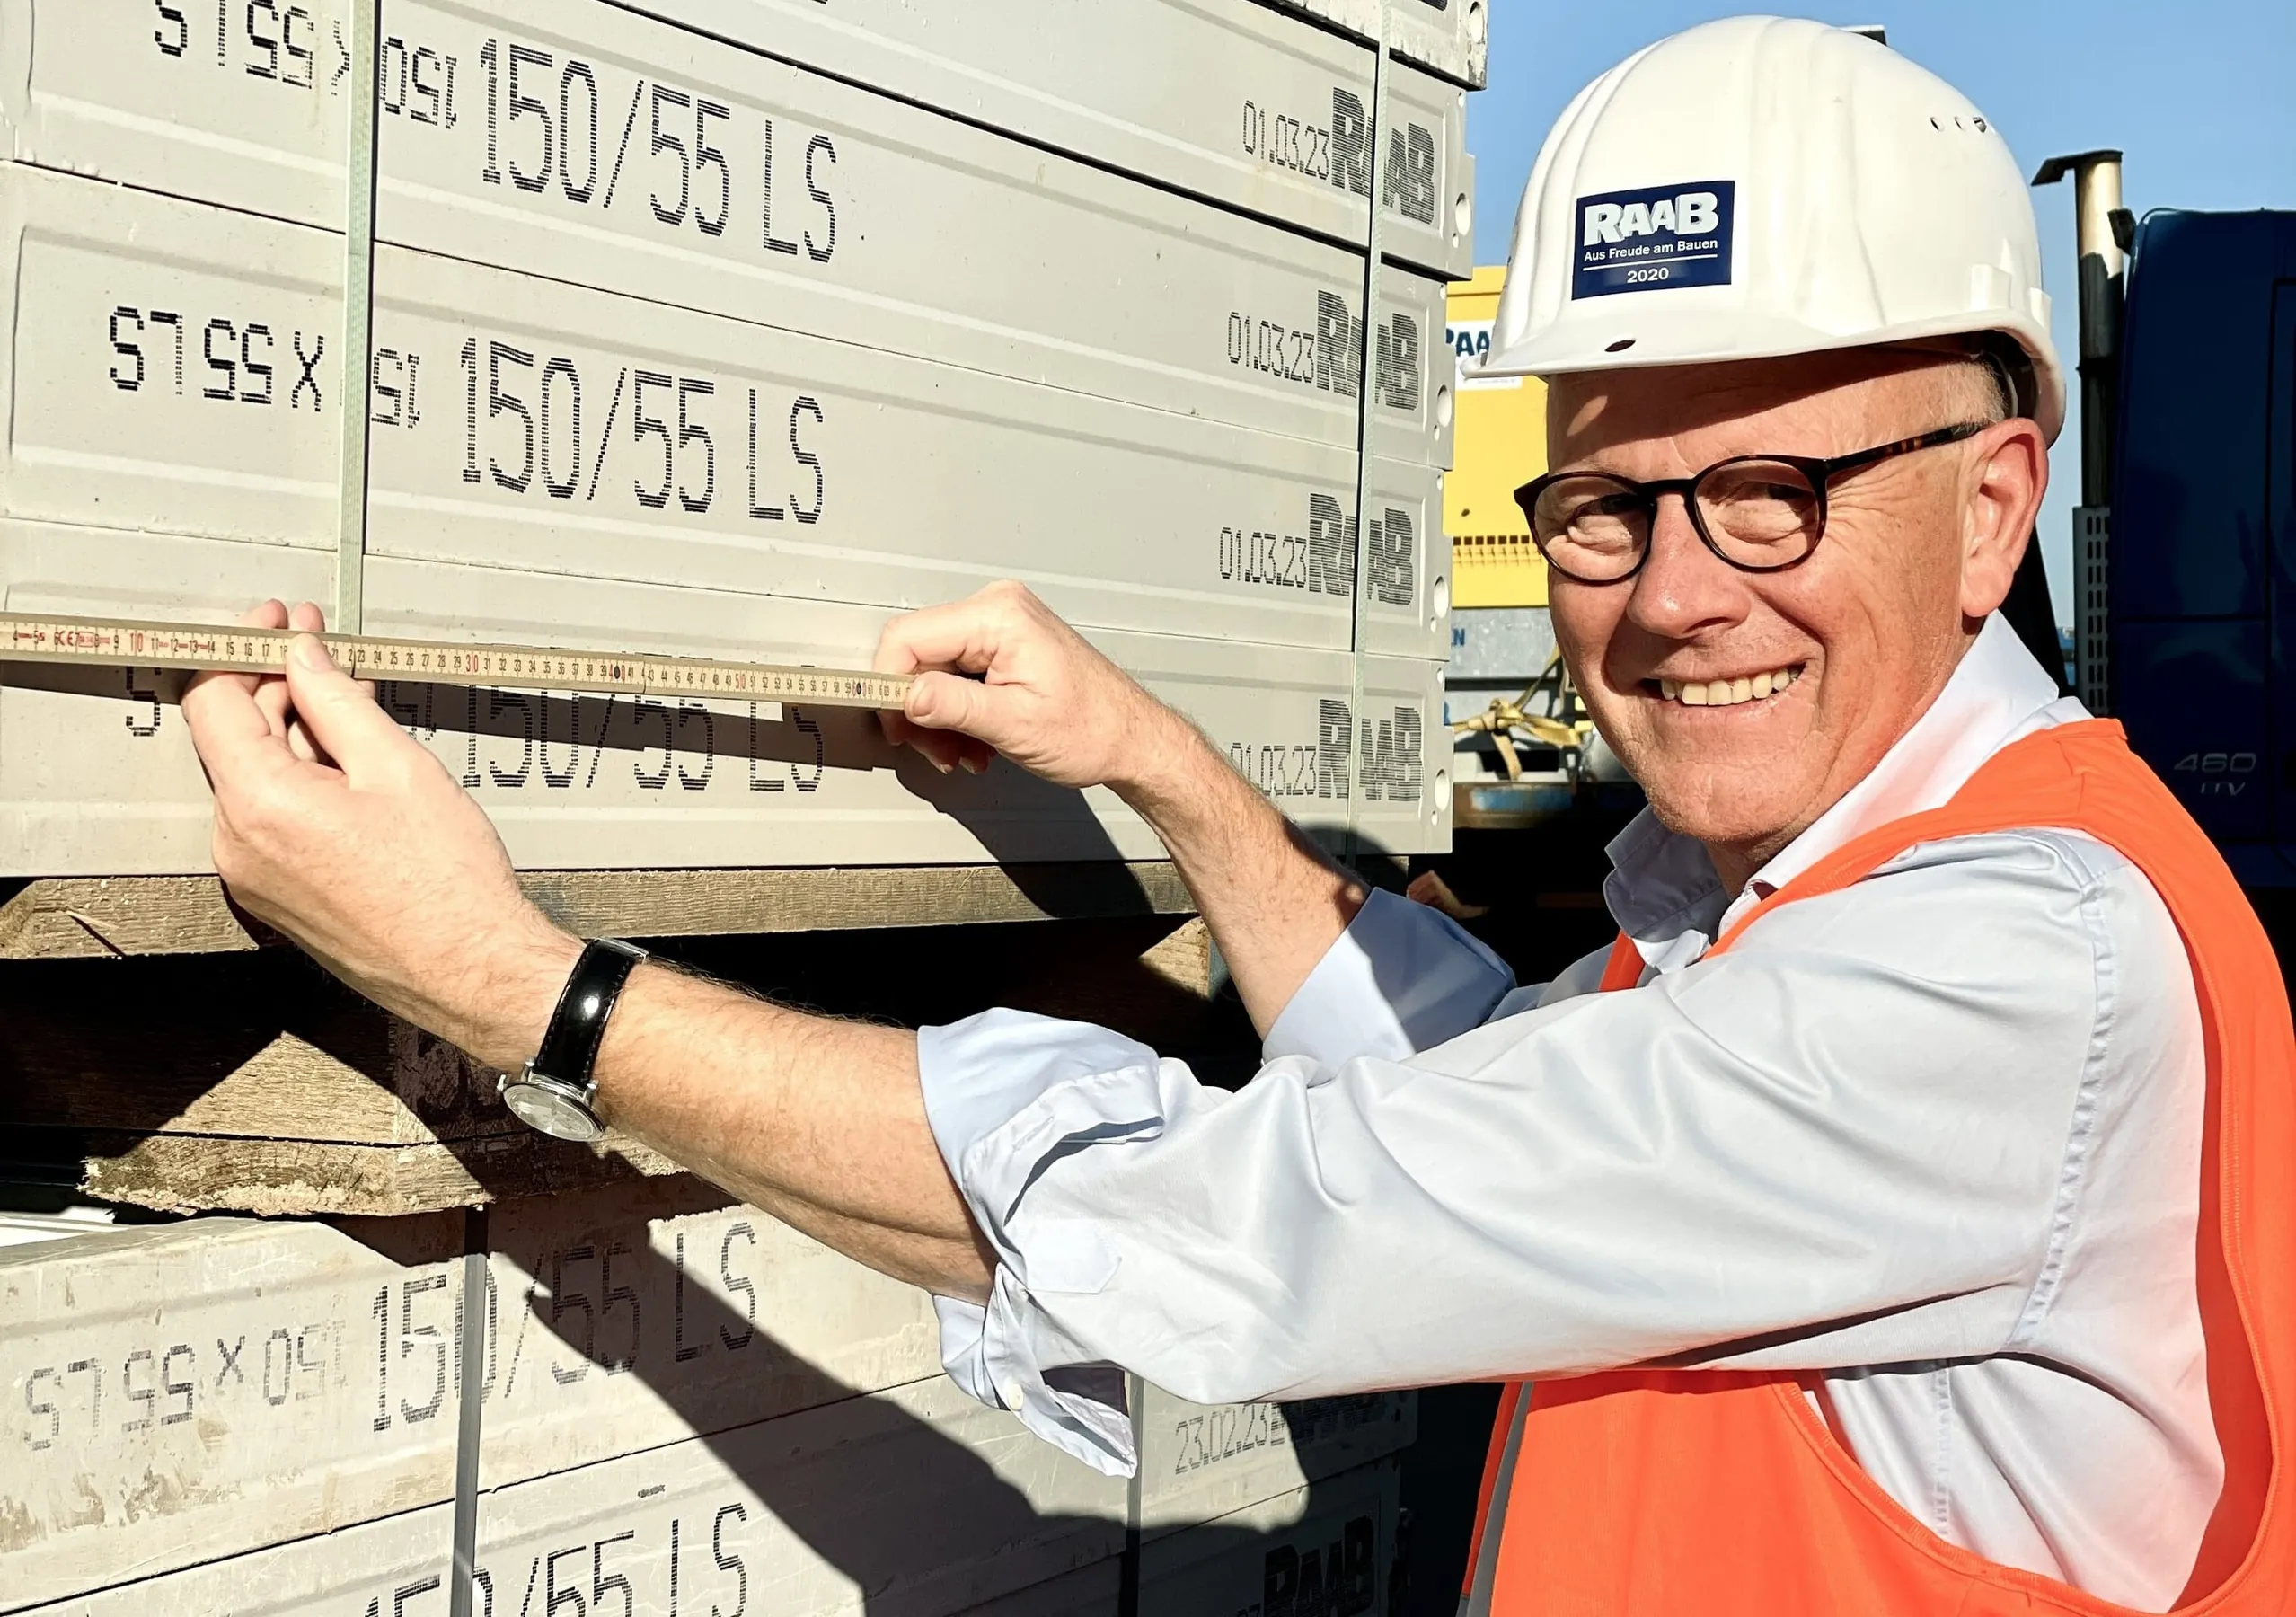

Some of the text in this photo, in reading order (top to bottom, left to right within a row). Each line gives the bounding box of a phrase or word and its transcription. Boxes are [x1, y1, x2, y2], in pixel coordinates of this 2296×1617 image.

[480, 38, 836, 262] 150/55 LS
[1584, 191, 1719, 247] RAAB
[1584, 239, 1718, 262] Aus Freude am Bauen
[1627, 267, 1669, 284] 2020
[460, 337, 824, 525] 150/55 LS
[113, 634, 119, 649] 9
[129, 632, 144, 653] 10
[151, 637, 159, 652] 11
[170, 638, 179, 653] 12
[189, 639, 198, 654] 13
[208, 641, 216, 655] 14
[226, 641, 235, 656] 15
[244, 643, 252, 657] 16
[261, 643, 270, 658] 17
[357, 649, 366, 663] 23
[373, 650, 382, 664] 24
[390, 651, 399, 665] 25
[406, 652, 414, 666] 26
[421, 653, 430, 667] 27
[437, 654, 446, 667] 28
[454, 655, 462, 668] 29
[465, 654, 479, 673] 30
[483, 658, 490, 671] 31
[499, 658, 507, 672] 32
[513, 659, 522, 672] 33
[528, 660, 536, 673] 34
[543, 661, 551, 674] 35
[557, 662, 565, 675] 36
[571, 662, 579, 676] 37
[586, 663, 594, 676] 38
[600, 664, 607, 677] 39
[608, 663, 626, 682] 40
[627, 667, 634, 678] 41
[648, 669, 655, 682] 43
[660, 670, 667, 683] 44
[674, 671, 681, 684] 45
[686, 672, 693, 685] 46
[699, 672, 707, 685] 47
[712, 674, 720, 685] 48
[725, 674, 732, 687] 49
[735, 673, 746, 690] 50
[675, 1222, 756, 1363] LS
